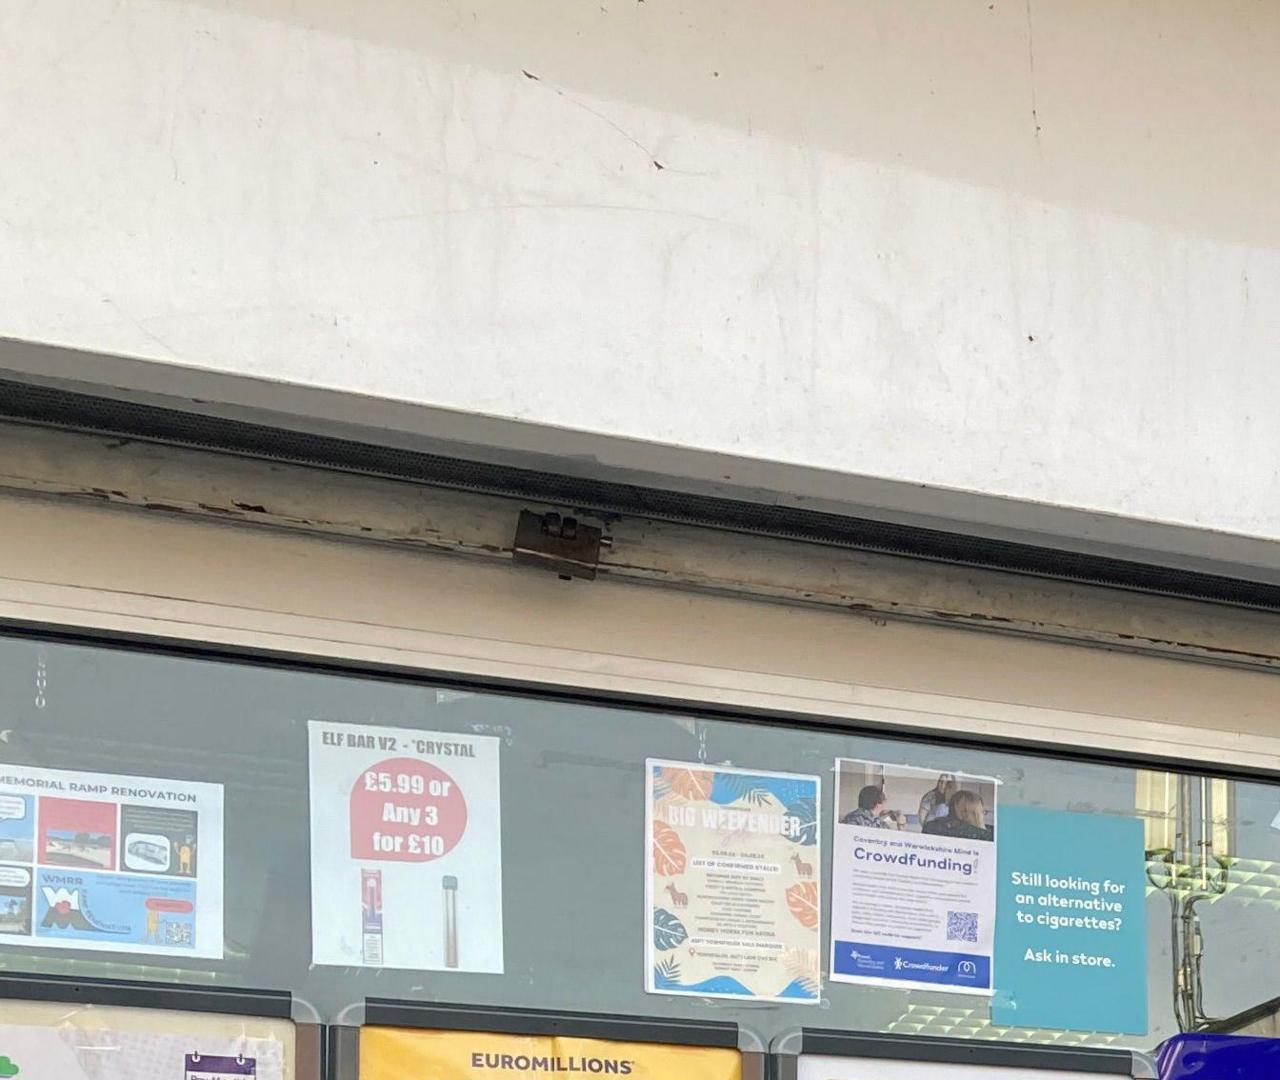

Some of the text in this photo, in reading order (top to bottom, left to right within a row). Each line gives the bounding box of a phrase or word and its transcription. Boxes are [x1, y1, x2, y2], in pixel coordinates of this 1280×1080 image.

[322, 731, 397, 752] ELF BAR V2
[69, 781, 197, 804] RAMP RENOVATION
[364, 771, 451, 797] £5.99 or
[382, 802, 439, 827] Any 3
[702, 808, 801, 837] WEEKENDER
[372, 832, 445, 856] for £10
[853, 834, 888, 848] Coventry
[889, 839, 903, 847] and
[904, 842, 953, 854] Warwickshire
[954, 846, 972, 857] Mind
[1011, 871, 1126, 895] Still looking for
[1015, 891, 1123, 912] an alternative
[1016, 909, 1122, 931] to cigarettes?
[1023, 947, 1116, 968] Ask in store.
[471, 1052, 634, 1075] EUROMILLIONS
